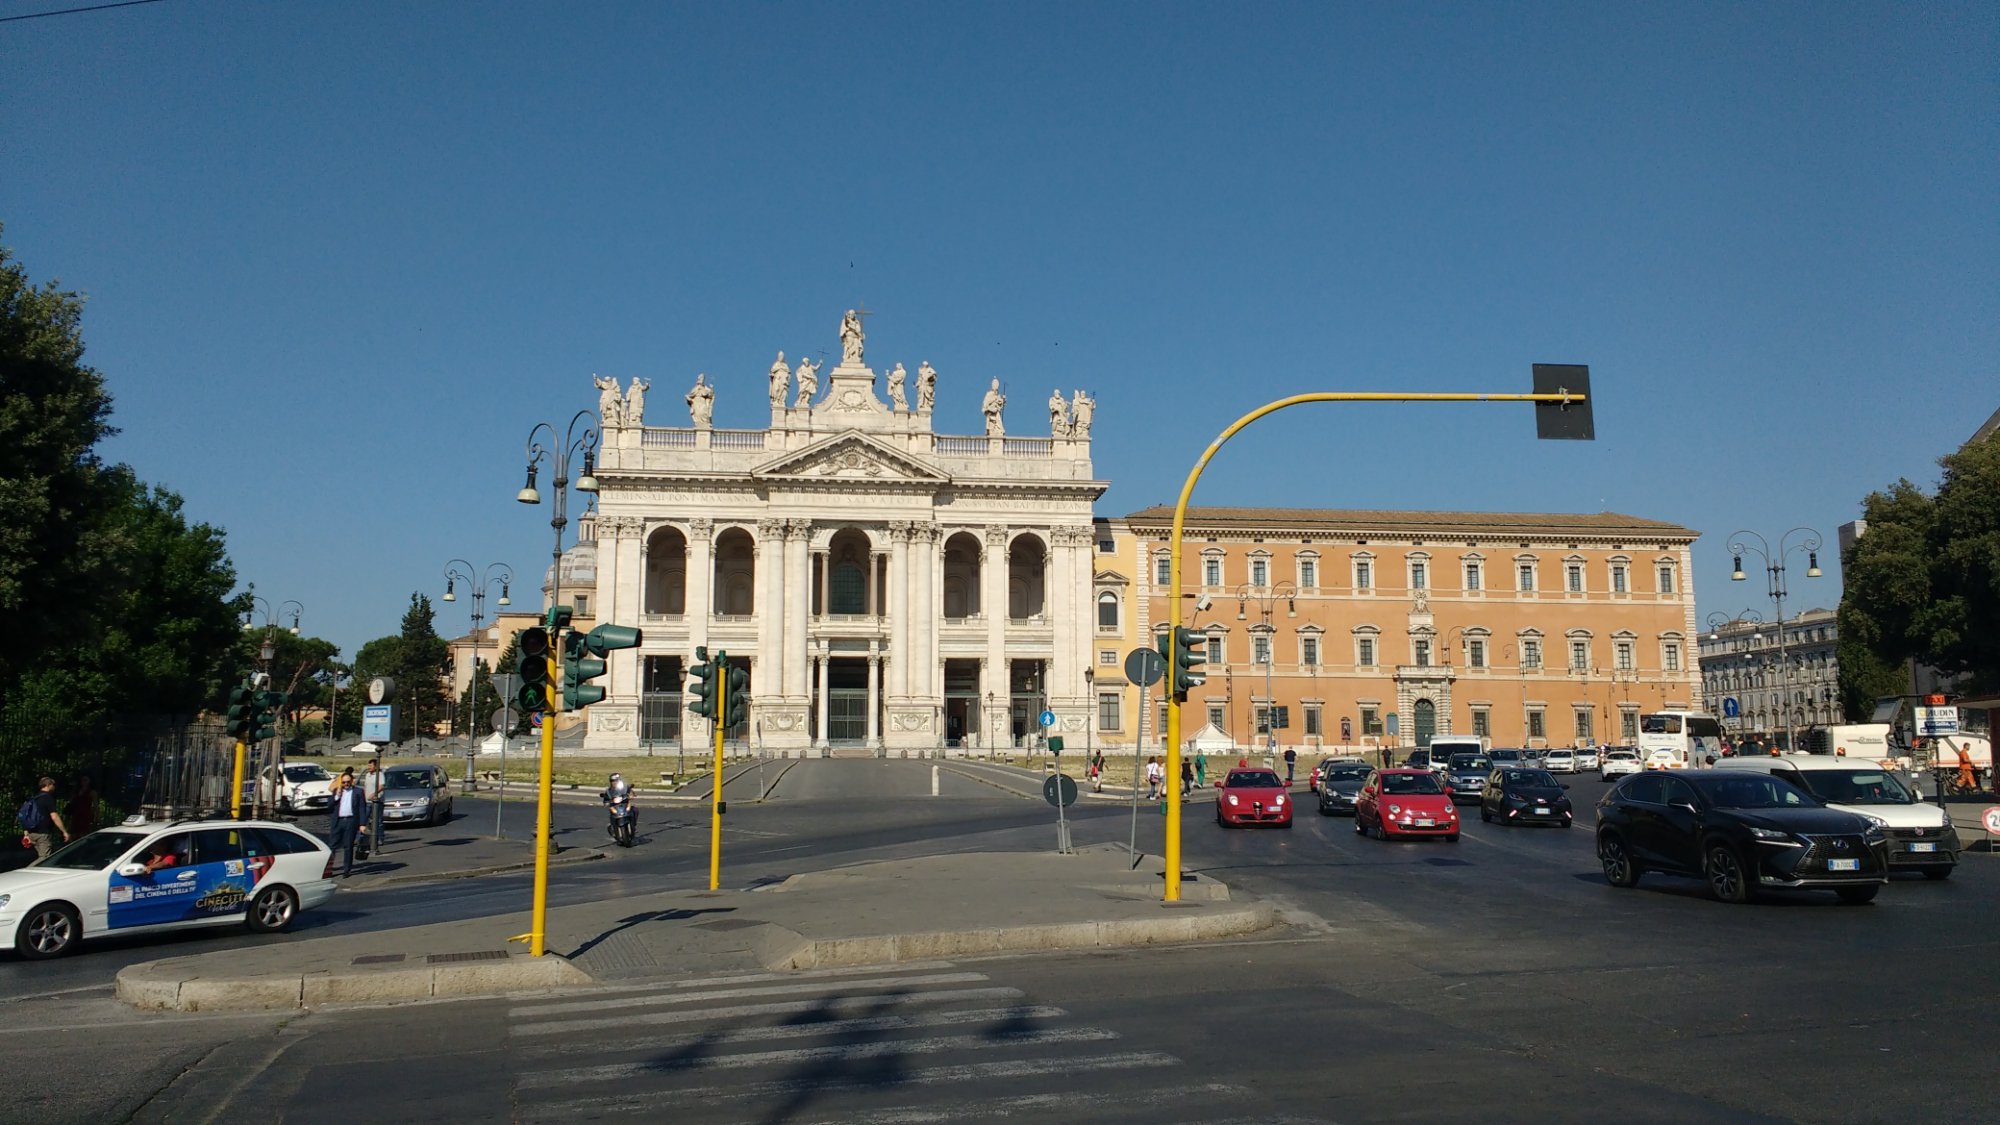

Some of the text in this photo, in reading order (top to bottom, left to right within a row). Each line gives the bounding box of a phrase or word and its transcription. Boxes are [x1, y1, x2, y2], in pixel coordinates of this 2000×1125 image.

[668, 493, 696, 502] PONT
[846, 496, 920, 505] SALVATORI
[1056, 502, 1090, 510] EVANG
[1926, 696, 1944, 704] TAXI
[141, 884, 161, 892] PARCO
[147, 890, 167, 898] CINEMA
